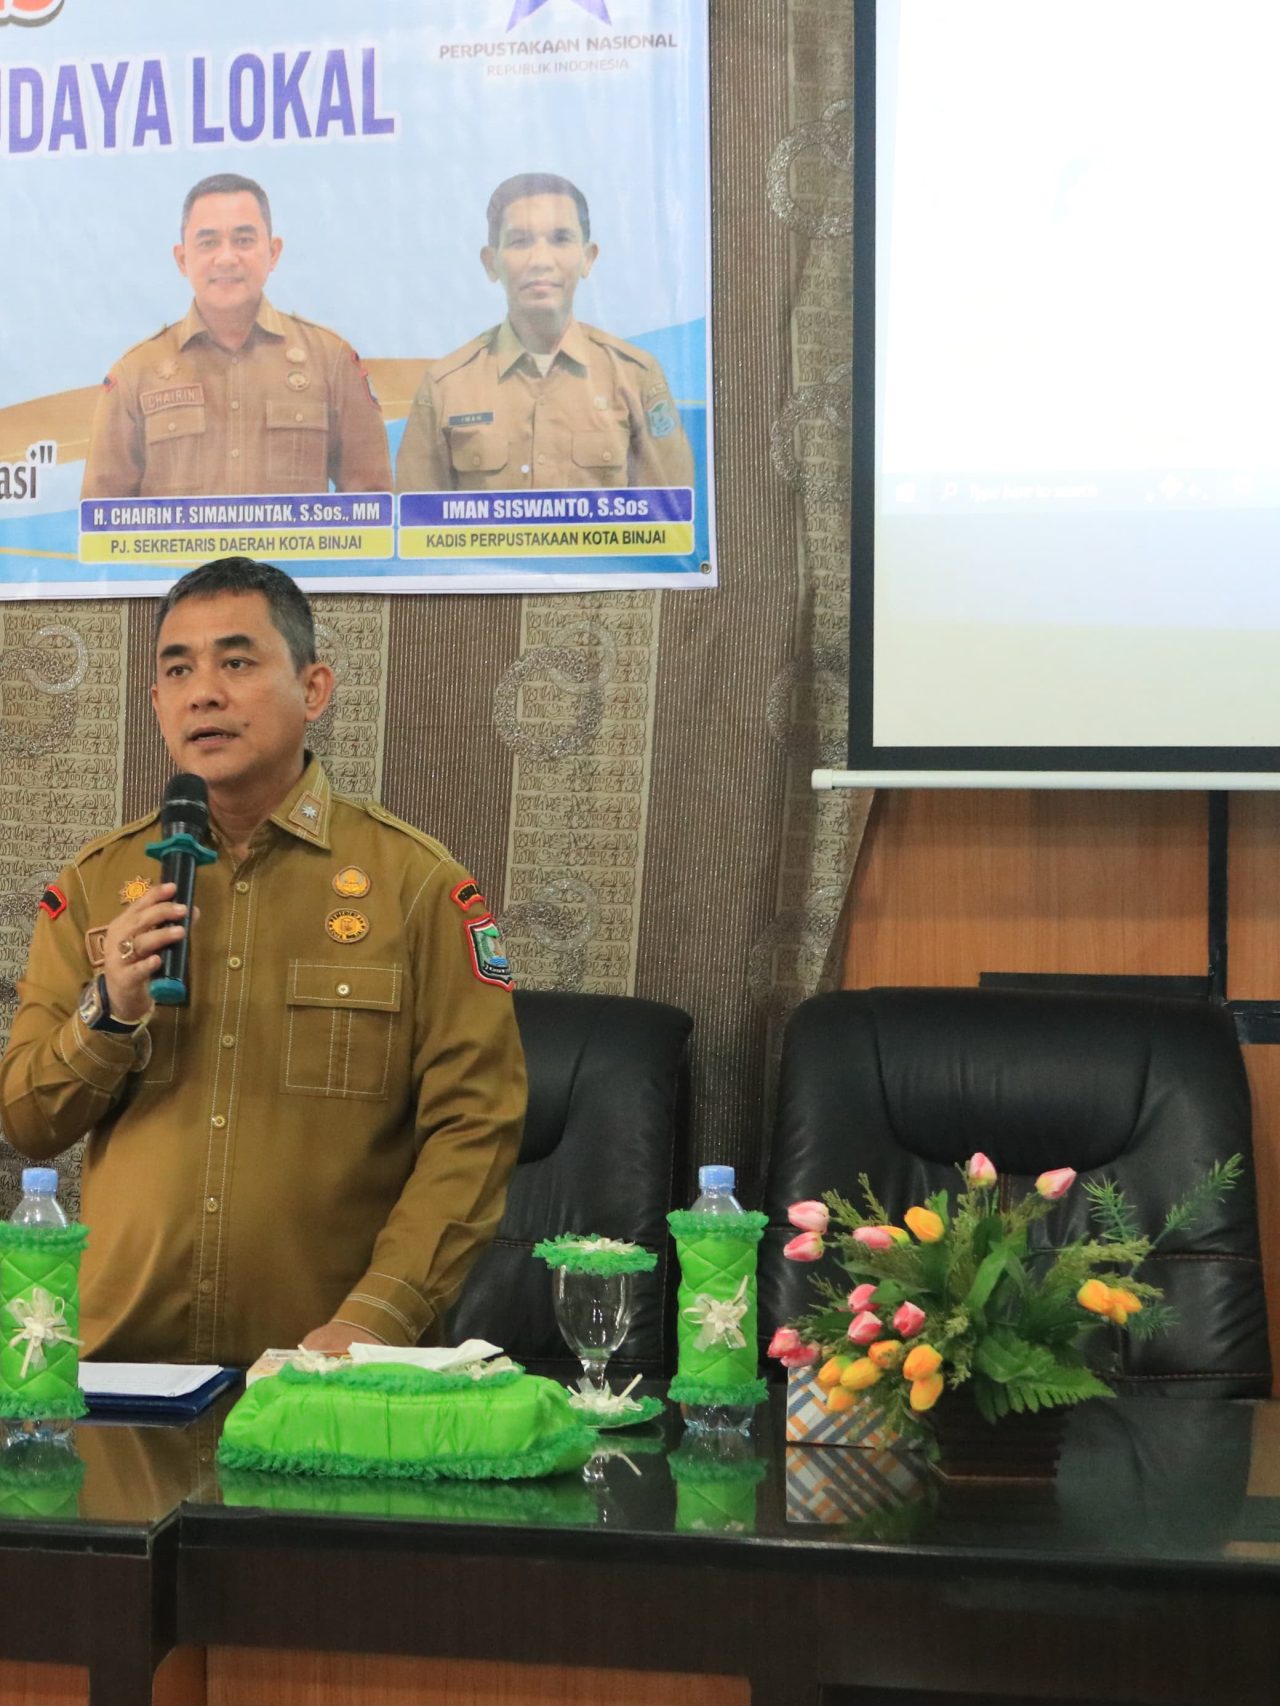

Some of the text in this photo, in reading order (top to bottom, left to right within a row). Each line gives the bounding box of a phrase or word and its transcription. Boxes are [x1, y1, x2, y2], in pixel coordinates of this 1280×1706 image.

[439, 34, 677, 59] PERPUSTAKAAN NASIONAL
[487, 58, 629, 76] REPUBLIK INDONESIA
[193, 48, 396, 142] LOKAL
[93, 502, 380, 525] H. CHAIRIN F. SIMANJUNTAK, S.Sos., MM
[442, 497, 649, 519] IMAN SISWANTO, S.Sos
[111, 535, 362, 553] PJ. SEKRETARIS DAERAH KOTA BINJAI
[426, 530, 665, 548] KADIS PERPUSTAKAAN KOTA BINJAI
